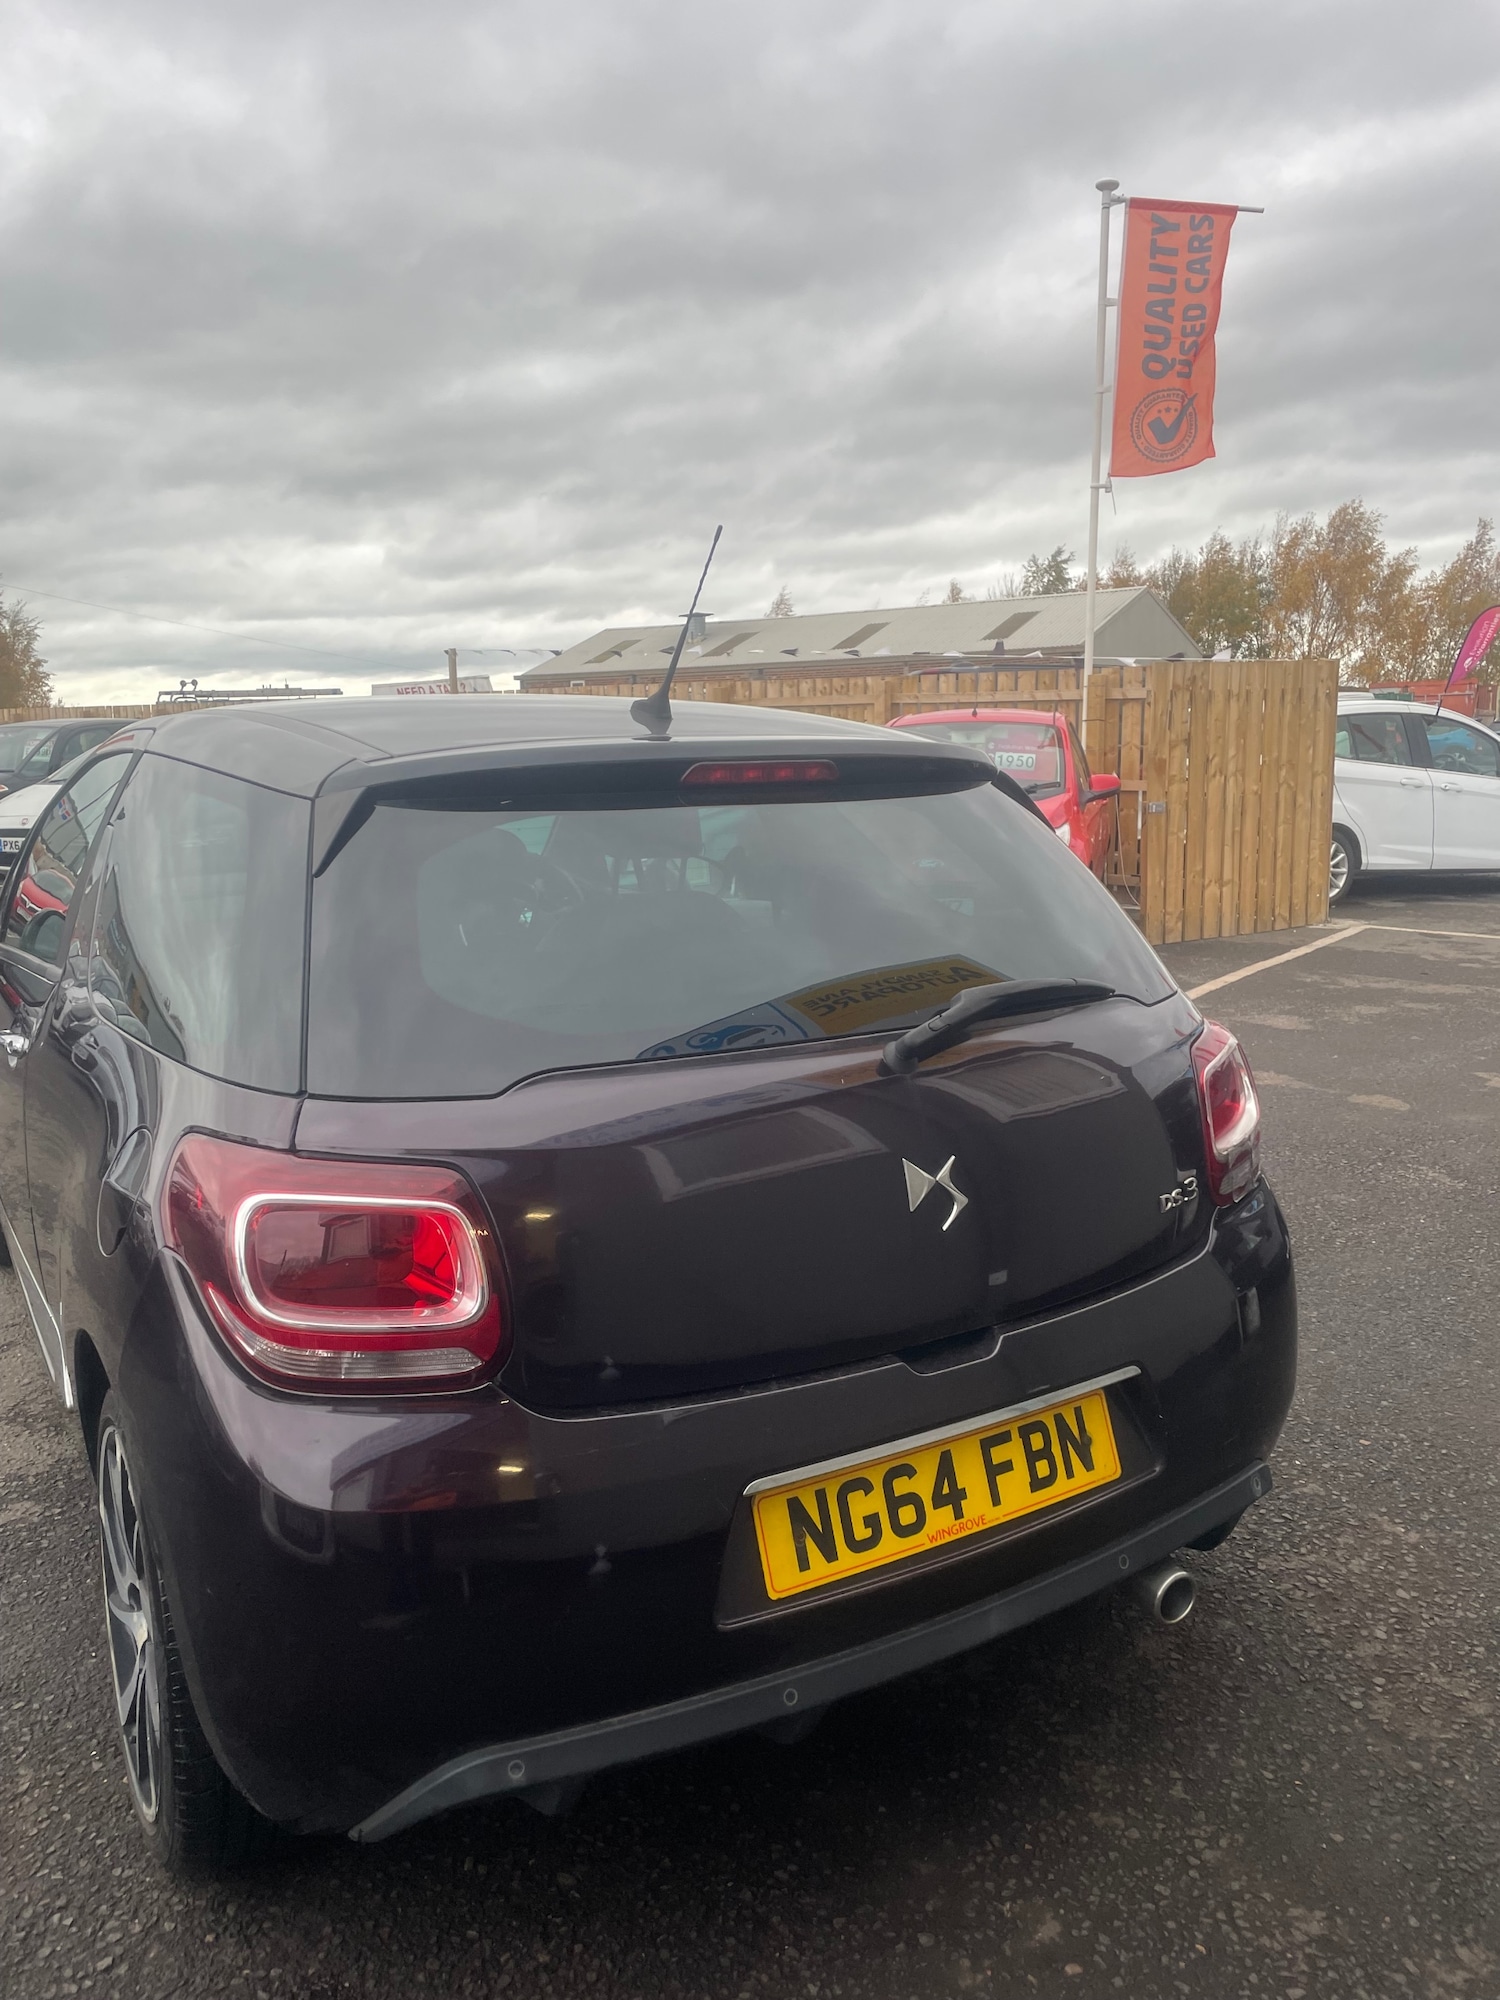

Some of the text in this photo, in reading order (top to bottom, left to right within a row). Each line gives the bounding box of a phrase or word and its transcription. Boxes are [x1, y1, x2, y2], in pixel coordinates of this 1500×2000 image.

[1142, 212, 1180, 380] QUALITY
[1176, 214, 1214, 379] USED CARS
[997, 754, 1034, 768] 1950
[3, 840, 20, 851] PX6
[787, 1406, 1095, 1573] NG64 FBN
[926, 1514, 988, 1544] WINGROVE
